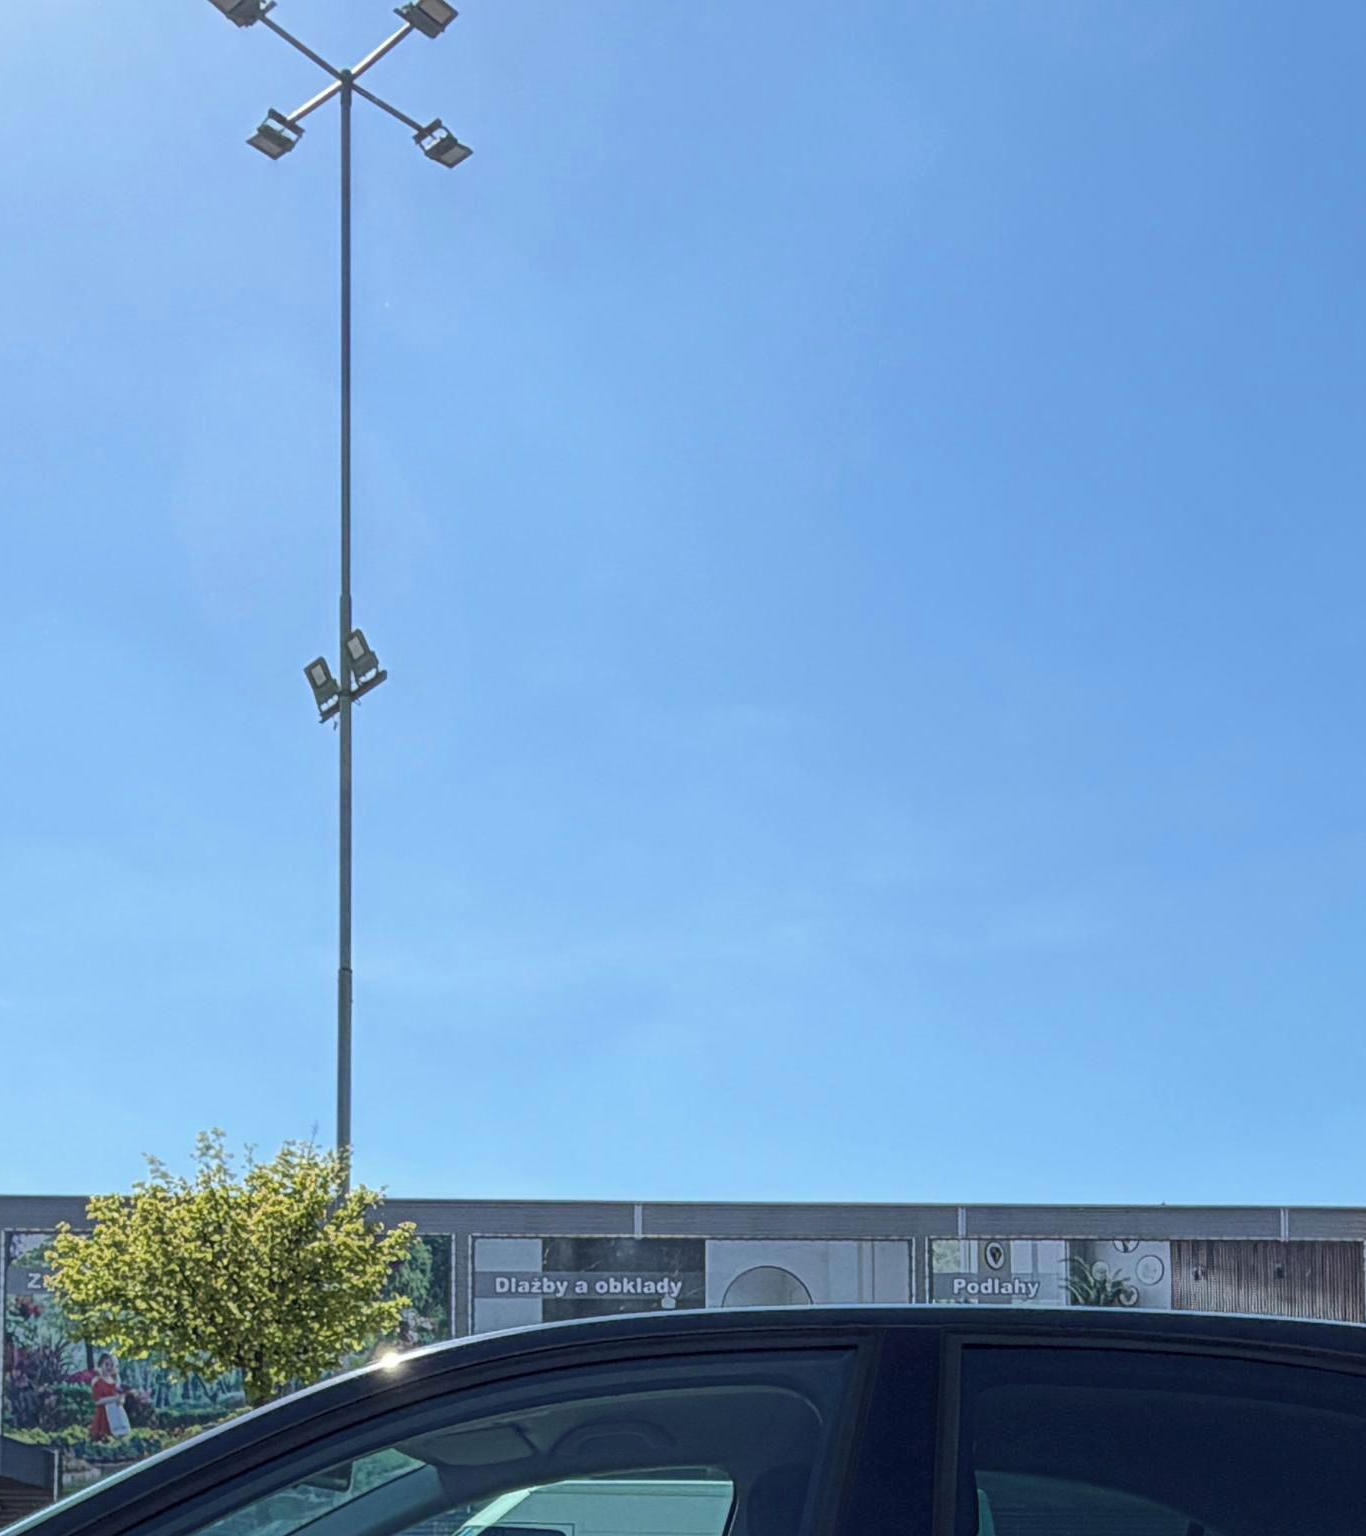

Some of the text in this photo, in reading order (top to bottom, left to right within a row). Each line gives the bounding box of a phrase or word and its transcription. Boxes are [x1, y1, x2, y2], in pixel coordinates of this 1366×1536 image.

[495, 1276, 682, 1297] Dlažby a obklady
[953, 1277, 1039, 1298] Podlahy
